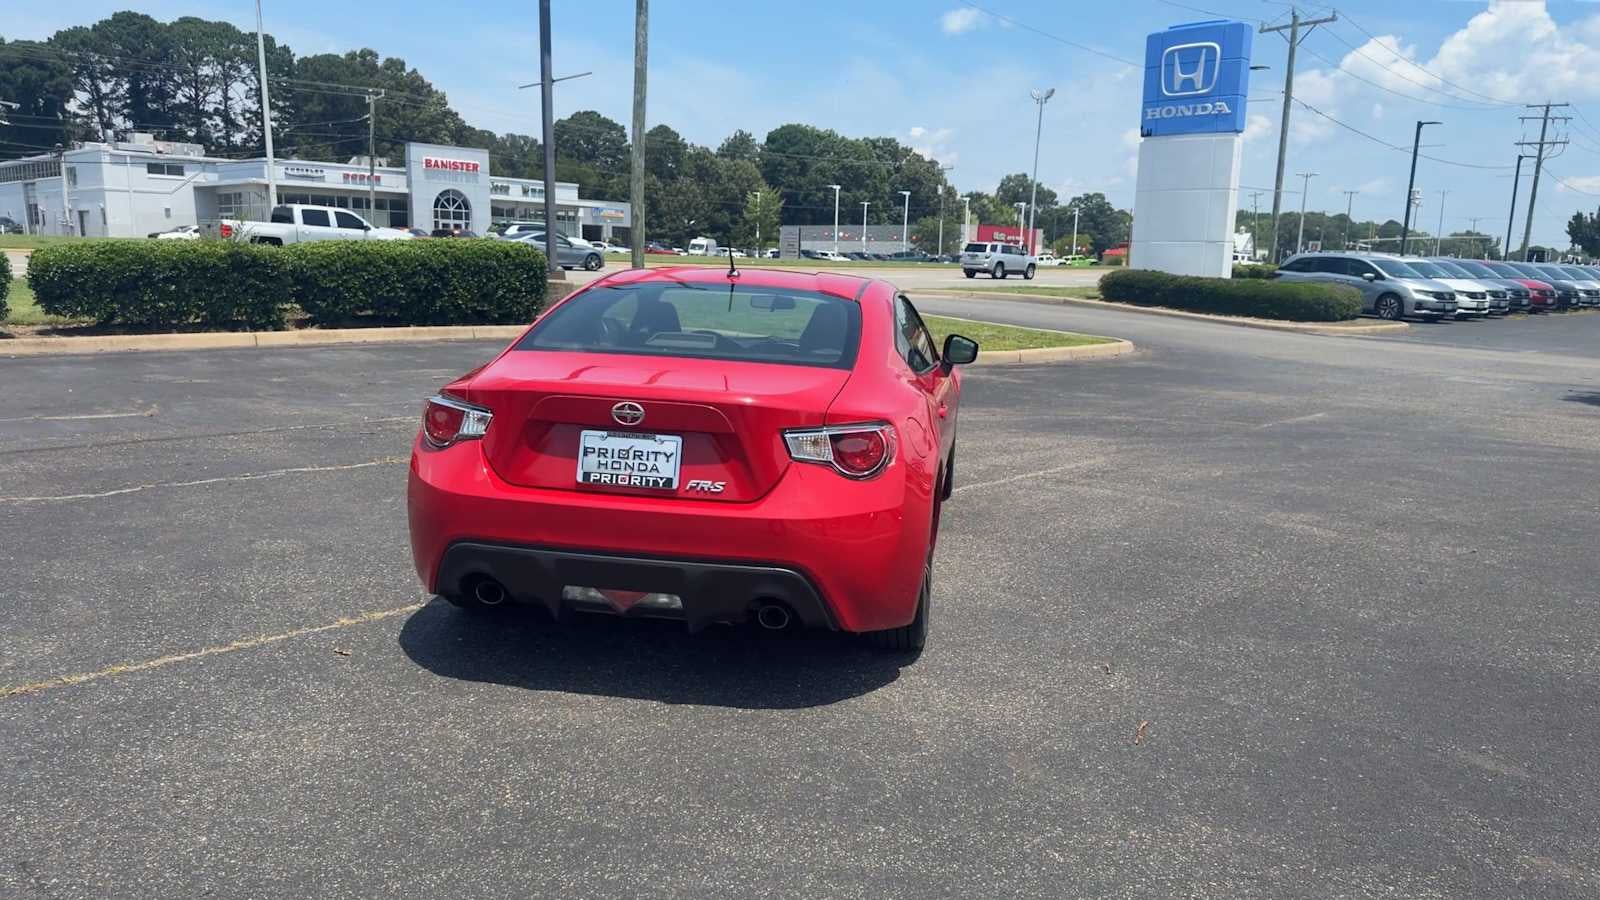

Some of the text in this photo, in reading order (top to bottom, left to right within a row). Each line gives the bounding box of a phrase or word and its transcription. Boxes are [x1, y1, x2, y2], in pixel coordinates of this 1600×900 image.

[1145, 102, 1231, 120] HONDA
[425, 158, 479, 172] BANISTER
[585, 445, 674, 462] PRIORITY
[598, 460, 660, 475] HONDA
[589, 473, 668, 486] PRIORITY
